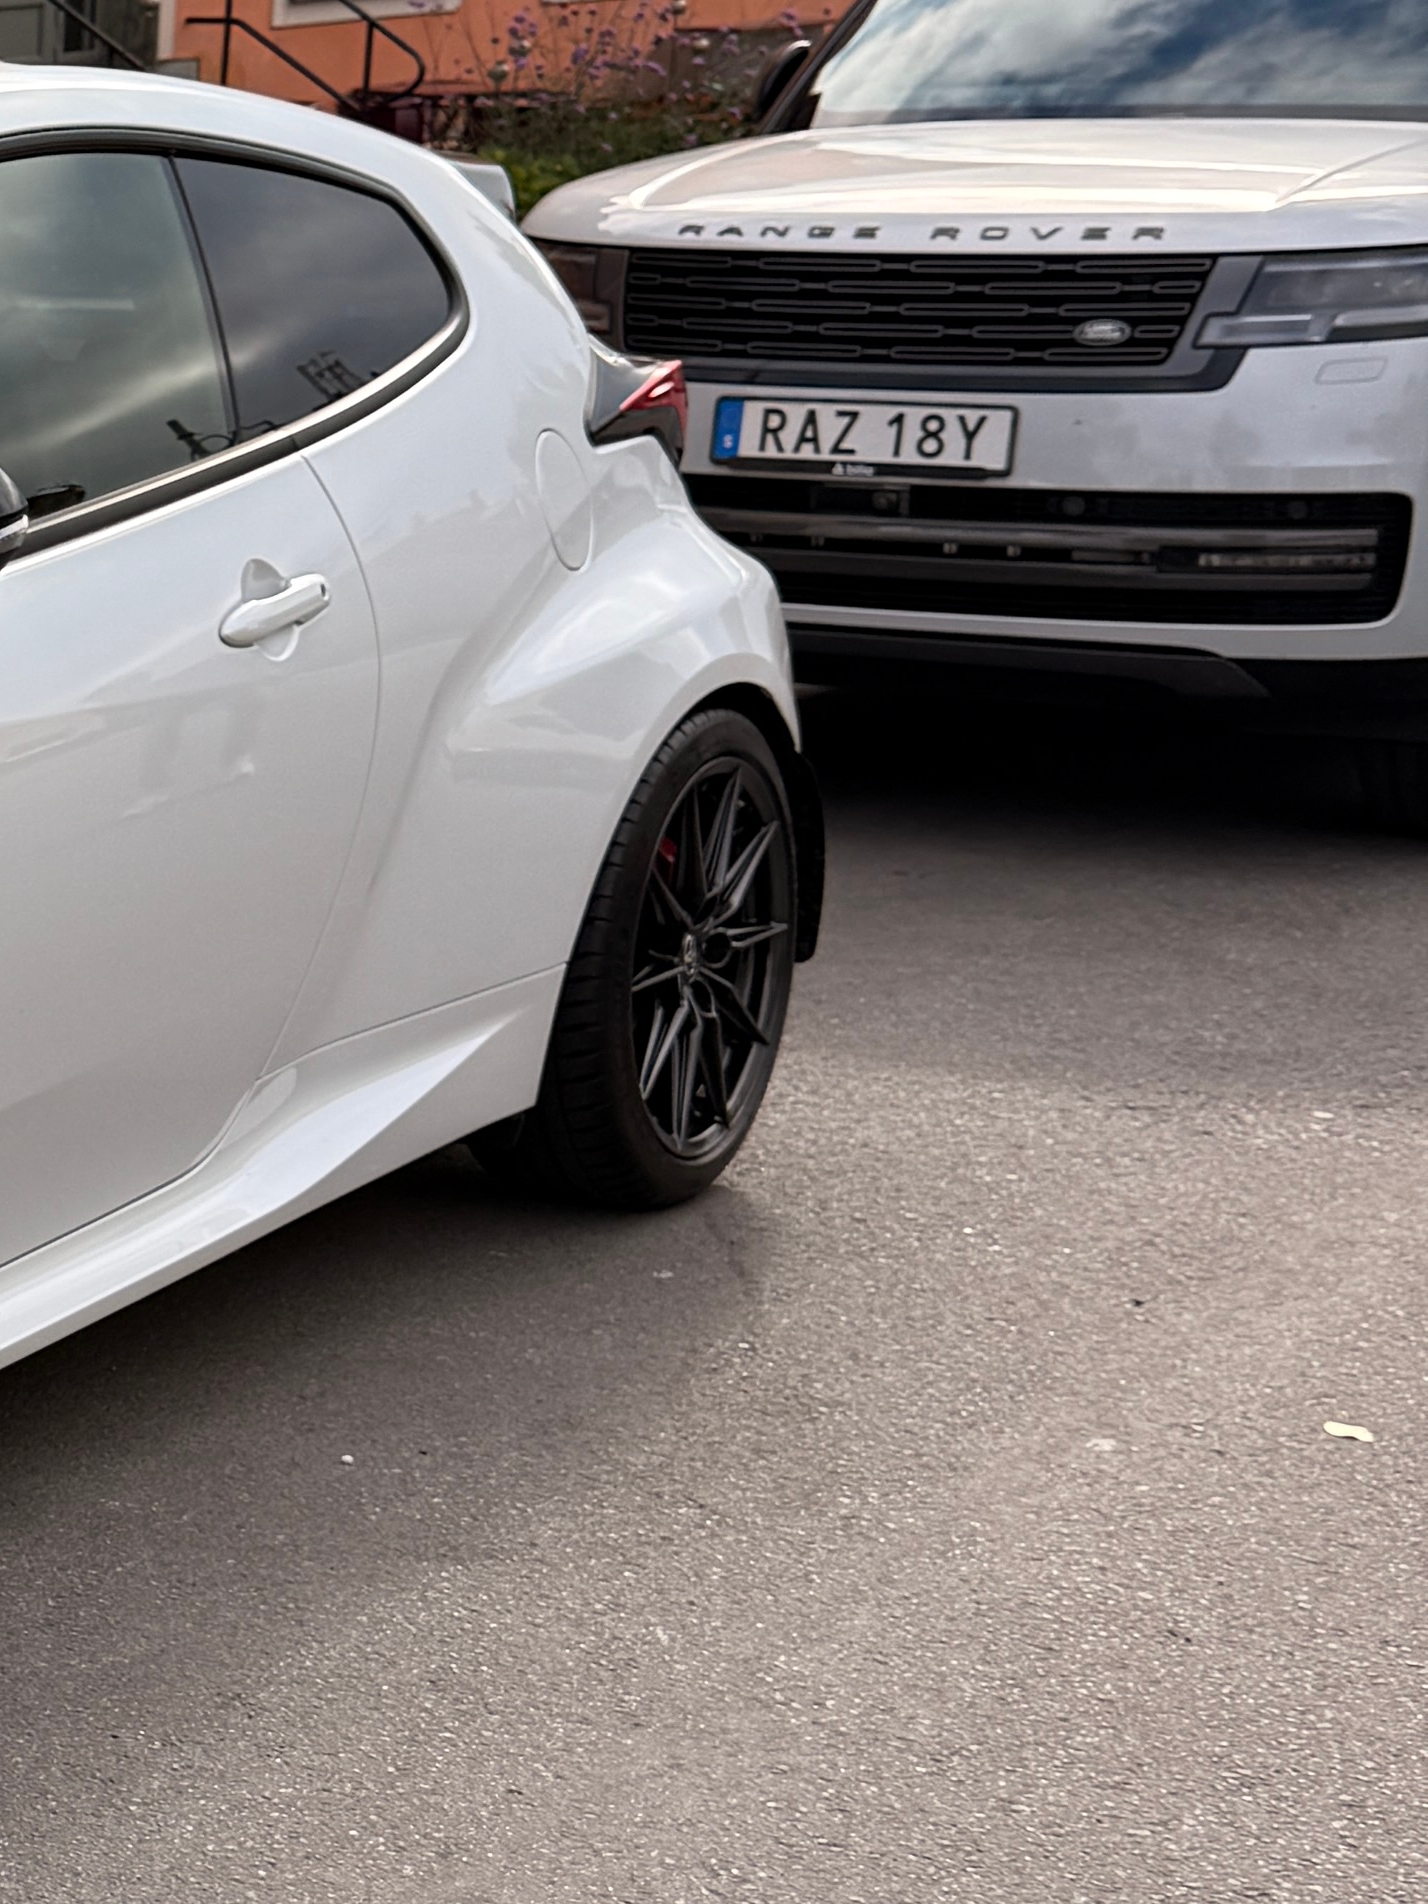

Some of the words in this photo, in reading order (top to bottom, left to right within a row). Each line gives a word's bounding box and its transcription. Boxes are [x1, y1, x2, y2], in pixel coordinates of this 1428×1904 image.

[678, 224, 882, 240] RANGE
[929, 225, 1166, 241] ROVER
[758, 408, 860, 455] RAZ
[888, 412, 987, 461] 18Y
